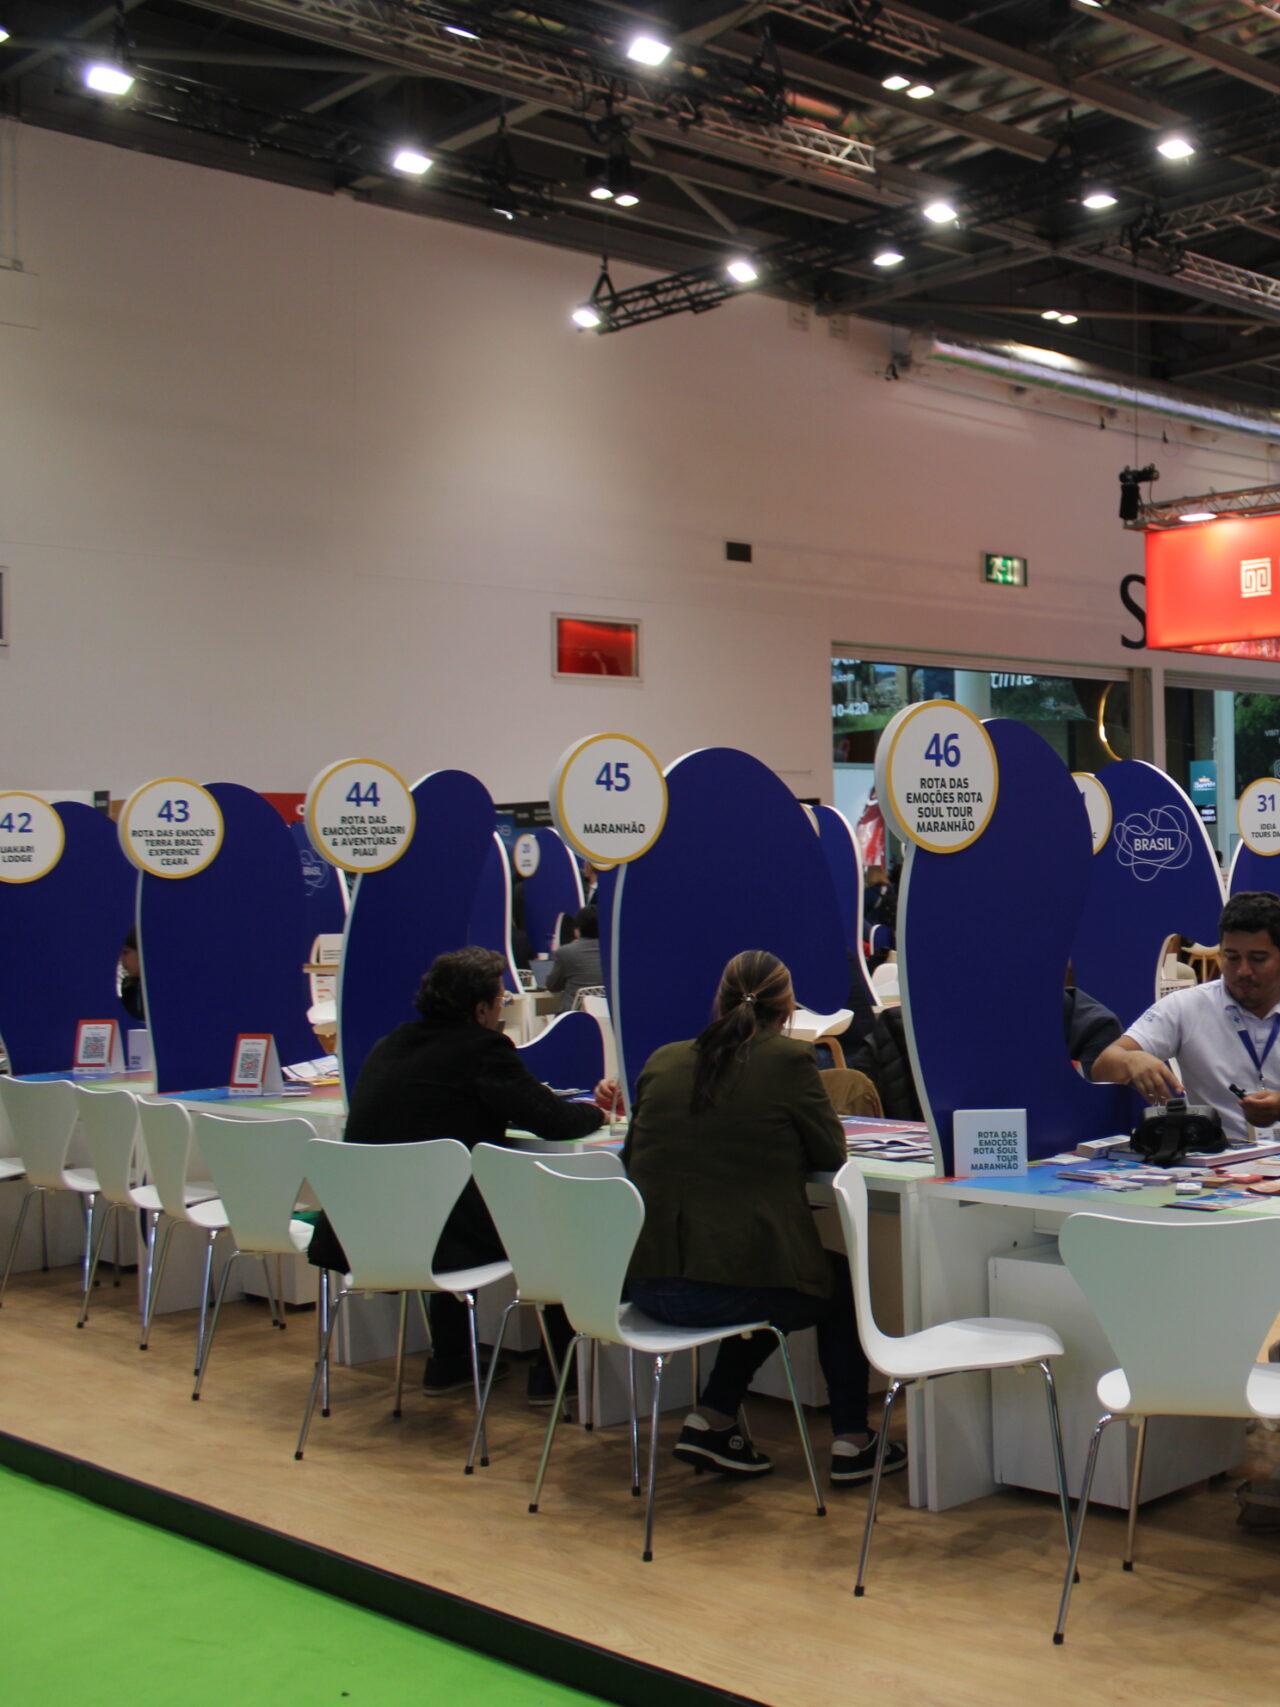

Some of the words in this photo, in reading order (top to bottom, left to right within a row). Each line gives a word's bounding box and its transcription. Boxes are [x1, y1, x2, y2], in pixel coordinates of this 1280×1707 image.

[924, 733, 961, 768] 46
[595, 762, 631, 791] 45
[920, 778, 947, 789] ROTA
[949, 778, 969, 789] DAS
[345, 782, 380, 807] 44
[906, 790, 955, 806] EMOÇÕES
[957, 792, 983, 803] ROTA
[1256, 794, 1276, 812] 31
[157, 800, 190, 822] 43
[917, 806, 944, 818] SOUL
[946, 806, 973, 817] TOUR
[0, 812, 34, 833] 42
[340, 816, 366, 825] ROTA
[368, 816, 387, 824] DAS
[916, 819, 975, 832] MARANHÃO
[131, 830, 154, 838] ROTA
[156, 829, 173, 837] DAS
[175, 828, 215, 838] EMOÇÕES
[322, 824, 368, 837] EMOÇÕES
[370, 825, 405, 836] QUADRI
[583, 823, 646, 834] MARANHÃO
[1251, 831, 1271, 839] TOURS
[145, 839, 171, 847] TERRA
[174, 838, 203, 846] BRAZIL
[331, 838, 338, 847] &
[341, 837, 397, 846] AVENTURAS
[1133, 838, 1175, 851] BRASIL
[148, 848, 200, 856] EXPERIENCE
[2, 855, 33, 863] LODGE
[978, 1131, 999, 1139] ROTA
[973, 1147, 995, 1155] ROTA
